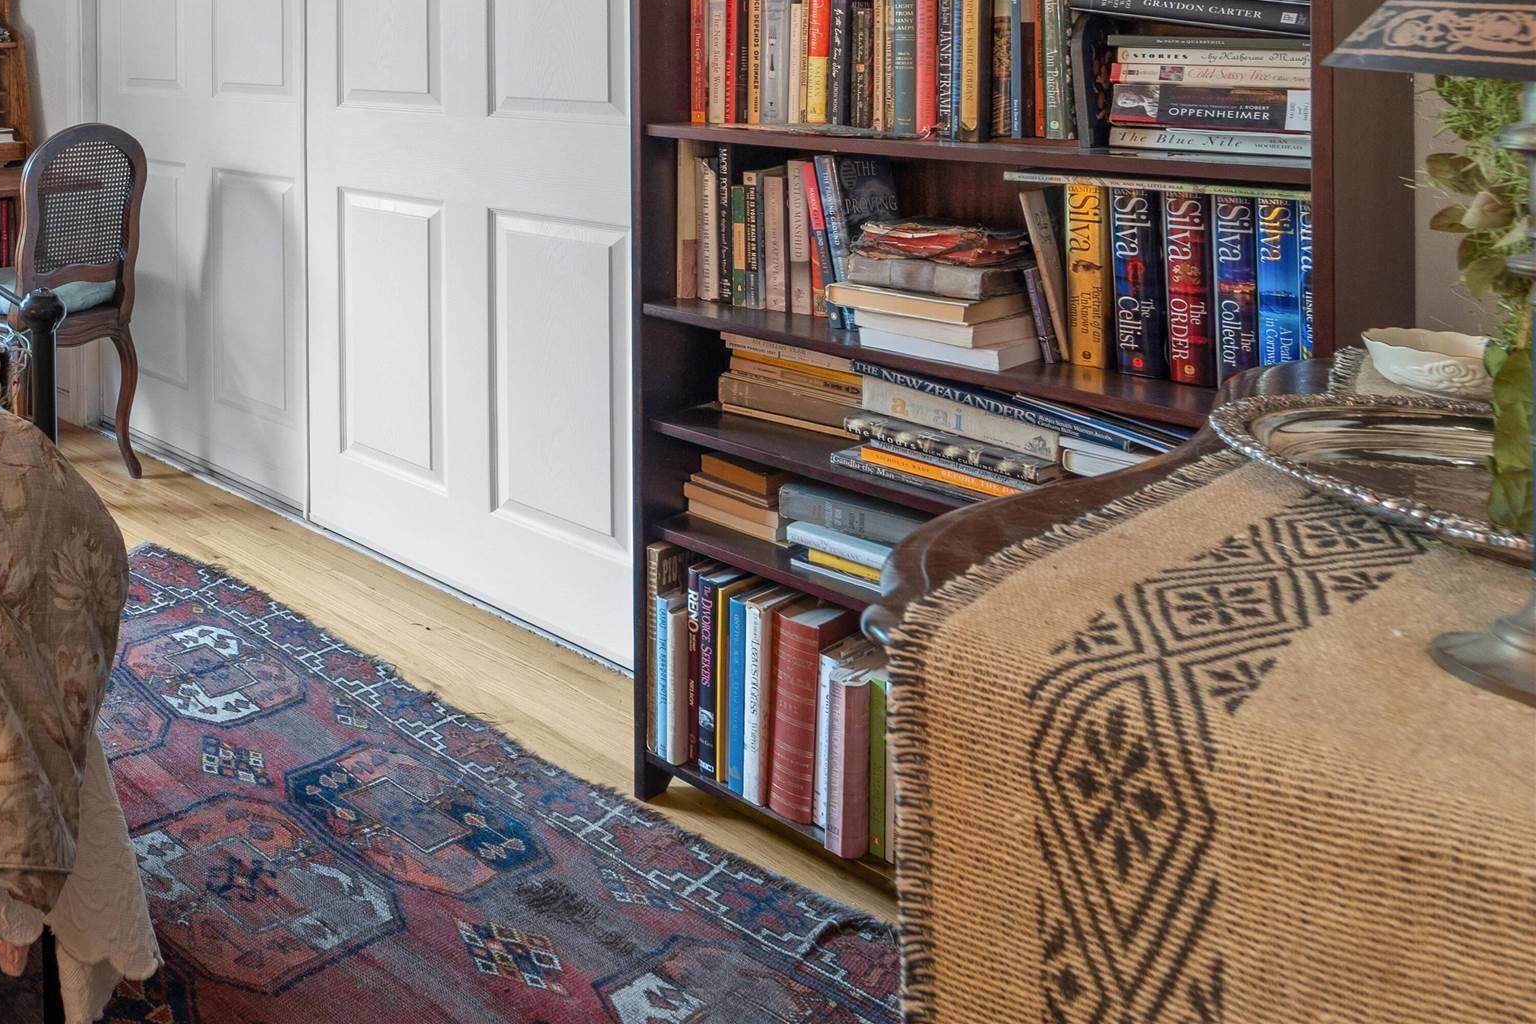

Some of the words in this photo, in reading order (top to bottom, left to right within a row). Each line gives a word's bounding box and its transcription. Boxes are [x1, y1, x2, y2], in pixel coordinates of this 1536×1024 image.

[1208, 6, 1262, 19] CARTER
[712, 51, 721, 73] Single
[939, 29, 951, 70] JANET
[1046, 48, 1058, 67] Ann
[966, 69, 974, 101] GIBRAN
[1188, 67, 1215, 79] Cold
[1249, 70, 1272, 81] Tree
[713, 76, 721, 104] Woman
[939, 73, 951, 116] FRAME
[1046, 70, 1059, 108] Patchett
[1168, 107, 1270, 121] OPPENHEIMER
[1120, 131, 1146, 142] The
[1156, 134, 1194, 144] Blue
[1203, 136, 1243, 148] Nile
[719, 148, 727, 174] MAORI
[854, 160, 877, 176] THE
[720, 178, 728, 206] POETRY
[823, 172, 831, 185] THE
[824, 187, 834, 215] PROVING
[845, 195, 897, 214] PROVING
[1217, 196, 1250, 204] DANIEL
[1259, 198, 1288, 206] DANIEL
[793, 211, 802, 258] MANSFIELD
[829, 217, 840, 245] GROUND
[1068, 193, 1102, 252] Silva
[1114, 195, 1150, 258] Silva
[1166, 198, 1205, 262] Silva
[1216, 203, 1253, 263] Silva
[1258, 204, 1295, 263] Silva
[1071, 295, 1079, 327] Woman
[1081, 292, 1091, 334] Unknown
[1092, 286, 1102, 319] Portrait
[1140, 299, 1156, 318] The
[1189, 301, 1207, 325] The
[1093, 321, 1102, 329] of
[1118, 296, 1142, 349] Cellist
[1170, 298, 1189, 360] ORDER
[1221, 300, 1242, 367] Collector
[1265, 318, 1276, 328] in
[1093, 331, 1100, 343] an
[1240, 330, 1255, 352] The
[1265, 329, 1278, 366] Cornwa
[855, 362, 879, 375] THE
[881, 370, 923, 393] NEW
[924, 382, 1037, 423] ZEALANDERS
[847, 424, 870, 437] The
[877, 431, 916, 450] Hours
[832, 455, 860, 469] Gandhi
[862, 464, 874, 472] the
[876, 467, 895, 479] Man
[922, 448, 955, 460] MICHAEL
[957, 457, 1011, 476] CUNNINGHAM
[941, 469, 977, 485] BEFORE
[981, 479, 999, 491] THE
[687, 588, 699, 633] RENO
[701, 597, 712, 640] DIVORCE
[701, 644, 712, 687] SEEKERS
[750, 641, 759, 676] Leaves
[750, 688, 760, 716] Grass
